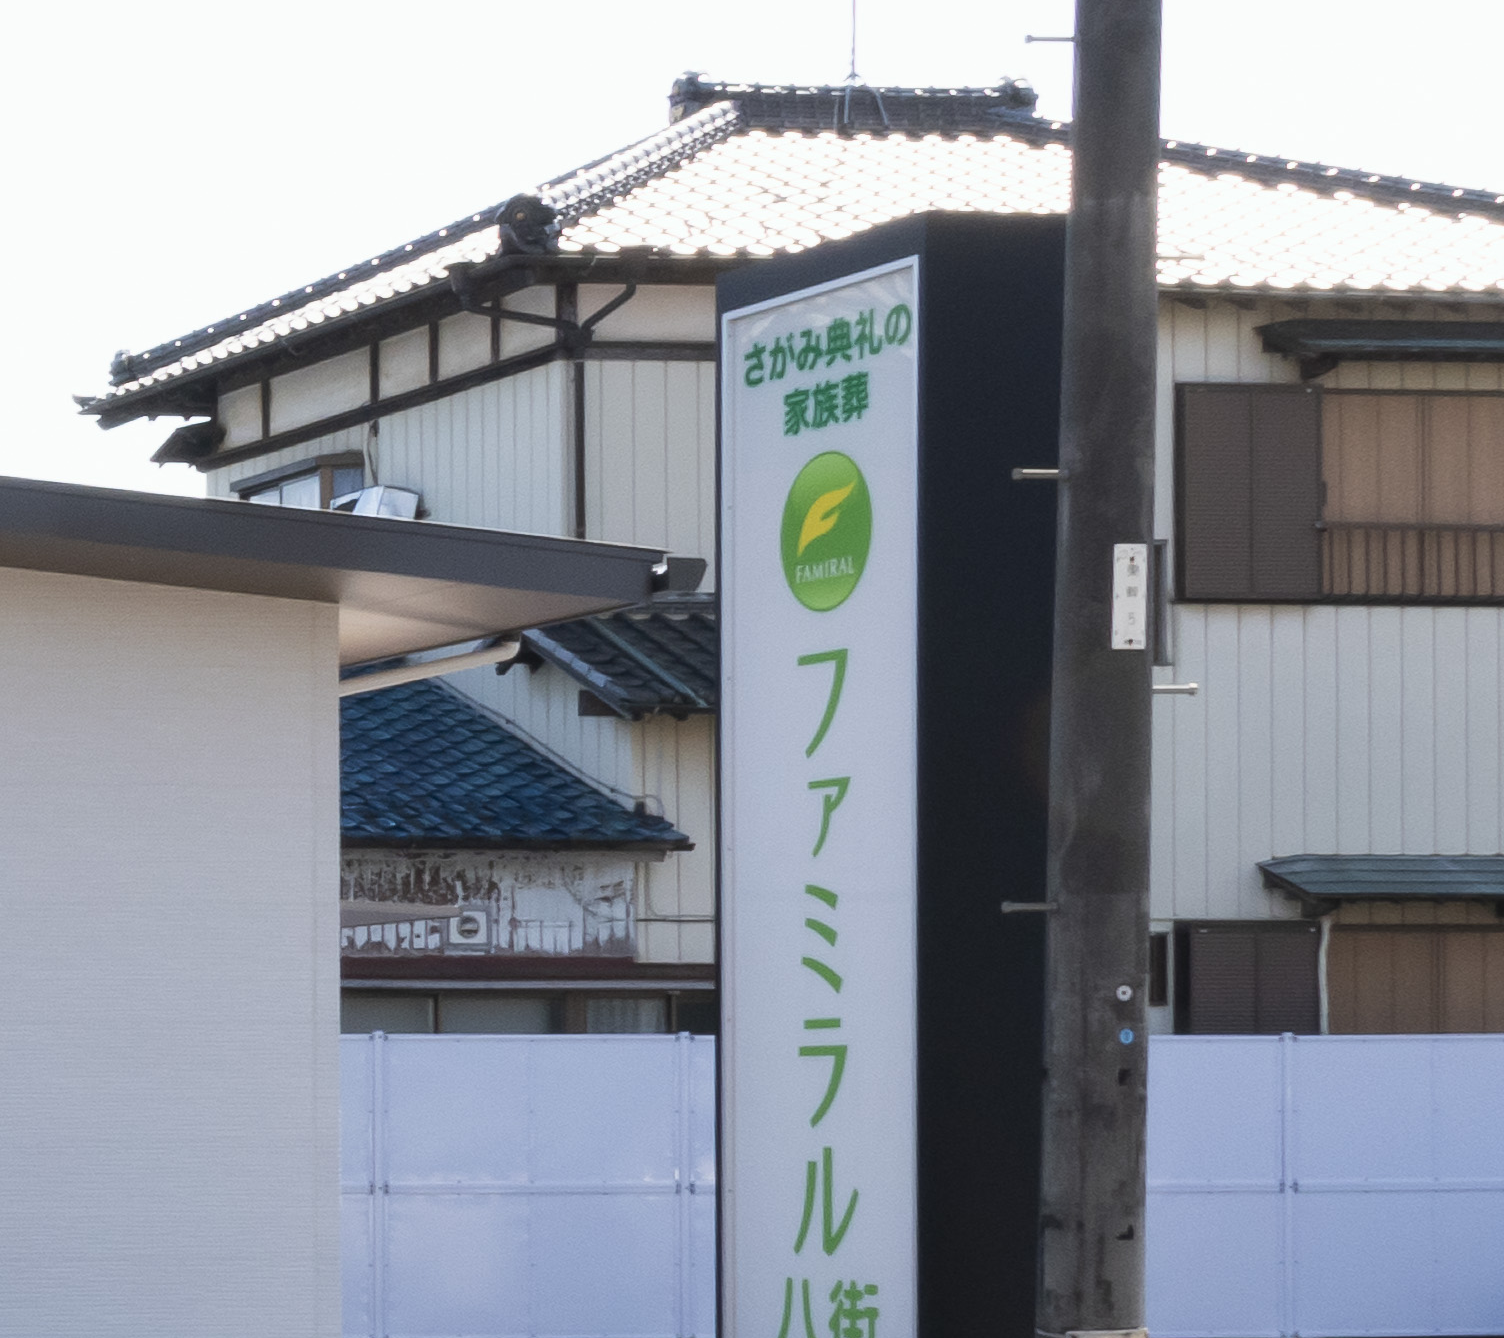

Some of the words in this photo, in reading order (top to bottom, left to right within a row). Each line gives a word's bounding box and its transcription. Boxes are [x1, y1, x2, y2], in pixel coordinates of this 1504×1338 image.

[743, 302, 912, 388] さがみ典礼の
[783, 371, 870, 437] 家族葬
[795, 555, 855, 584] FAMIRAL
[792, 647, 860, 1257] ファミラル
